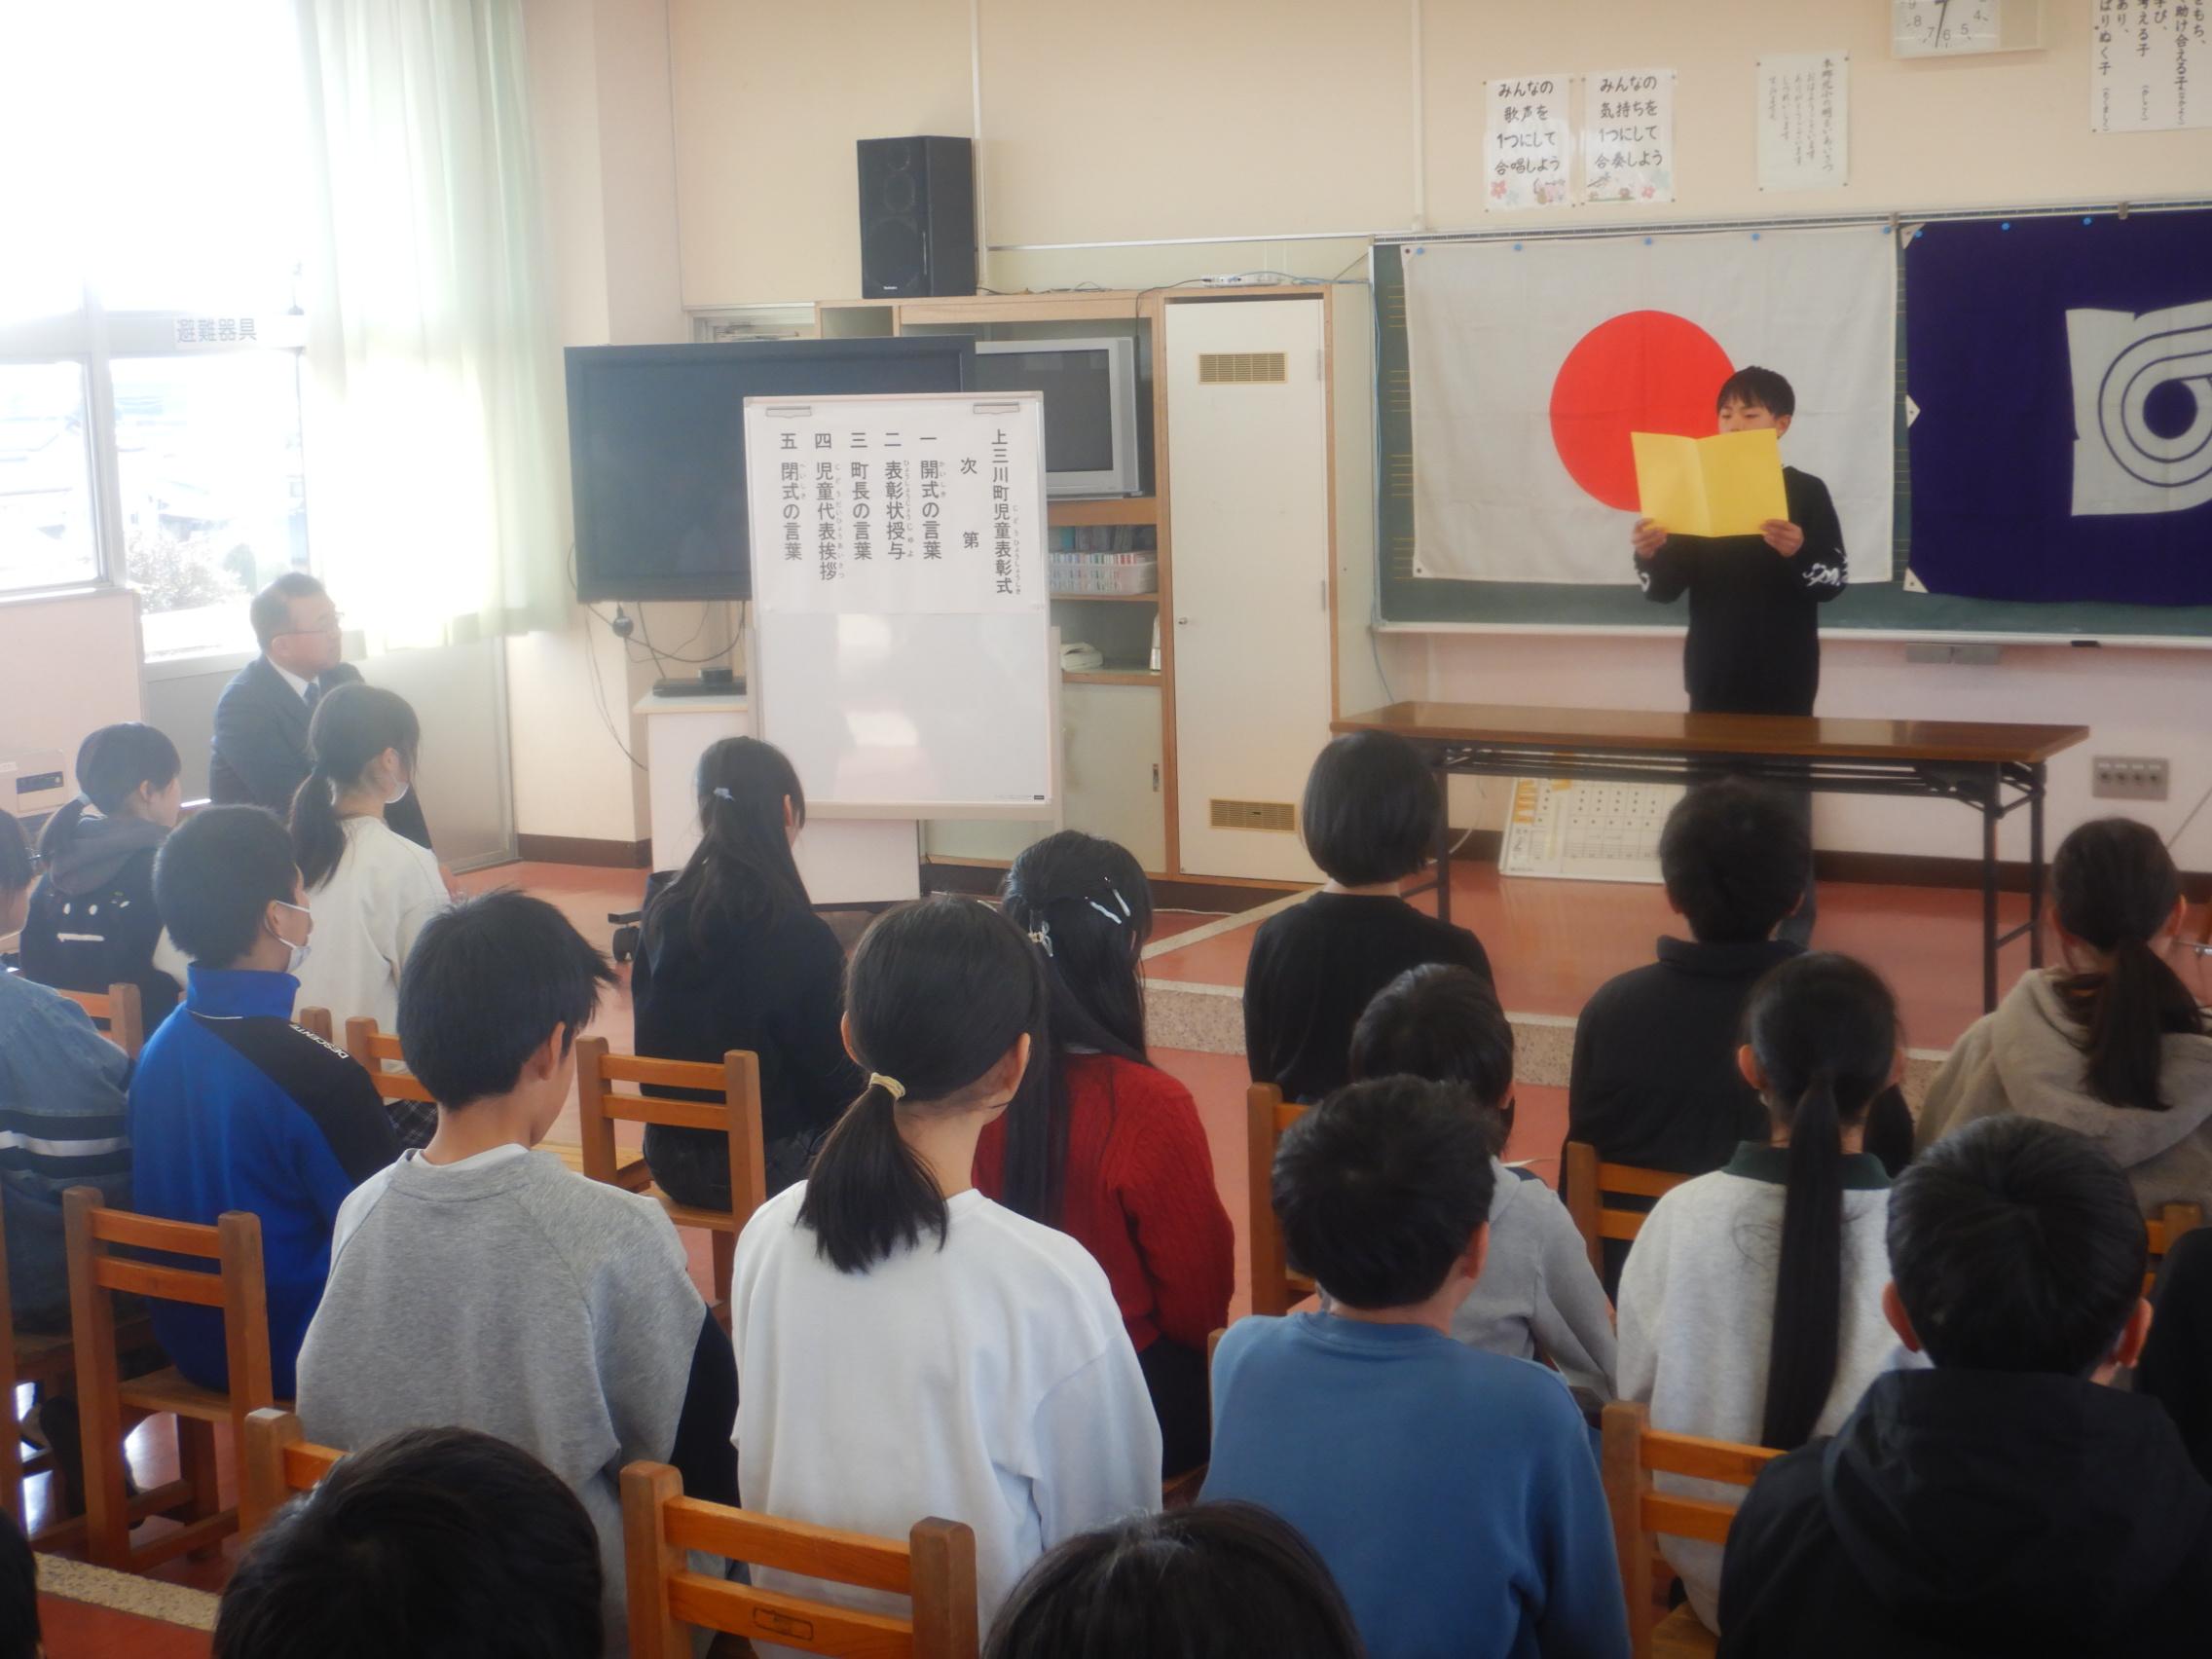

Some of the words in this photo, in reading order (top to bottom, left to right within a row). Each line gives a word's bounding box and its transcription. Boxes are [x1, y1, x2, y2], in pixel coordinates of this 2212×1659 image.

[1913, 15, 1922, 27] 8
[1972, 10, 1981, 20] 4
[1928, 26, 1936, 38] 7
[1943, 29, 1951, 41] 6
[1961, 23, 1969, 35] 5
[2174, 0, 2189, 88] 助け合える子
[1498, 80, 1554, 98] みんなの
[1600, 75, 1657, 93] みんなの
[1504, 104, 1549, 124] 歌声を
[1600, 99, 1658, 120] 気持ちを
[1496, 131, 1556, 149] 1つにして
[1598, 125, 1658, 142] 1つにして
[1494, 155, 1560, 175] 合唱しよう
[1595, 149, 1663, 169] 合奏しよう
[176, 317, 258, 344] 避難器具
[780, 432, 797, 450] 五
[814, 432, 832, 449] 四
[850, 431, 868, 449] 三
[884, 431, 902, 448] 二
[960, 457, 977, 475] 次
[781, 461, 802, 561] 閉式の言葉
[851, 461, 872, 561] 町長の言葉
[884, 460, 906, 561] 表彰状授与
[920, 460, 941, 561] 開式の言葉
[991, 428, 1014, 595] 上三川町児童表彰式
[816, 461, 837, 581] 児童代表挨拶
[962, 532, 979, 549] 第
